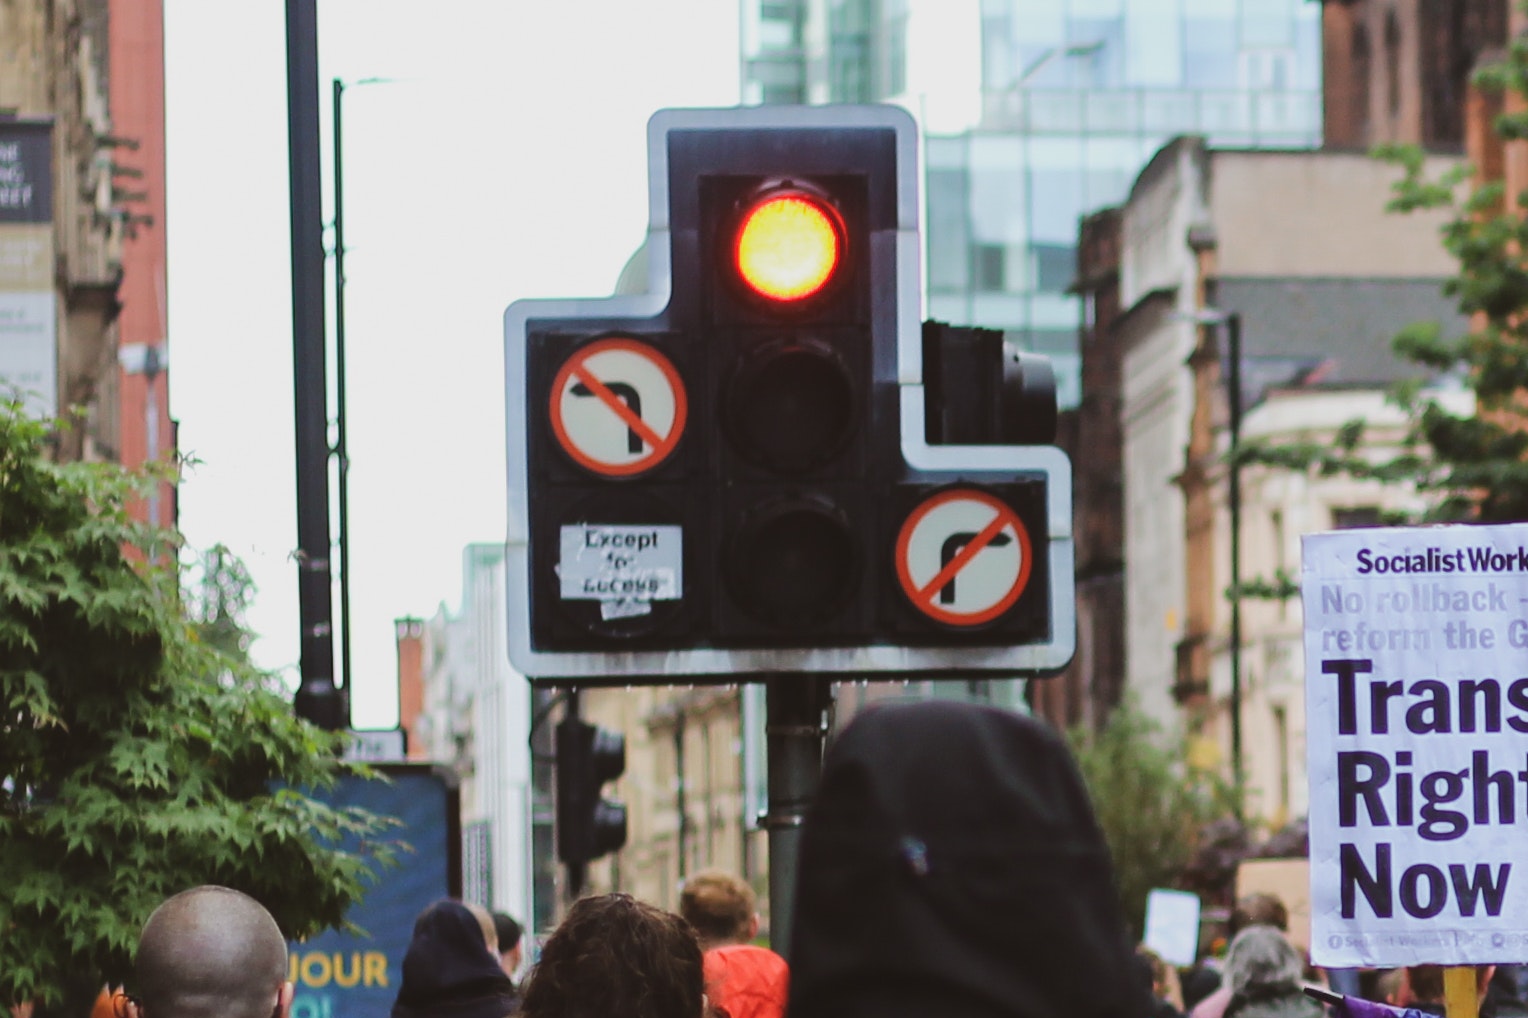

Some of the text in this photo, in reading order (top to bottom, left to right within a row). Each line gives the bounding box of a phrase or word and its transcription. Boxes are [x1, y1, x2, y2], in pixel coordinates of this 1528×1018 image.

[585, 529, 659, 551] Except
[1356, 547, 1465, 574] Socialist
[1321, 584, 1364, 615] No
[1377, 582, 1507, 614] rollback
[1321, 622, 1432, 652] reform
[1445, 621, 1496, 650] the
[1339, 843, 1512, 920] Now
